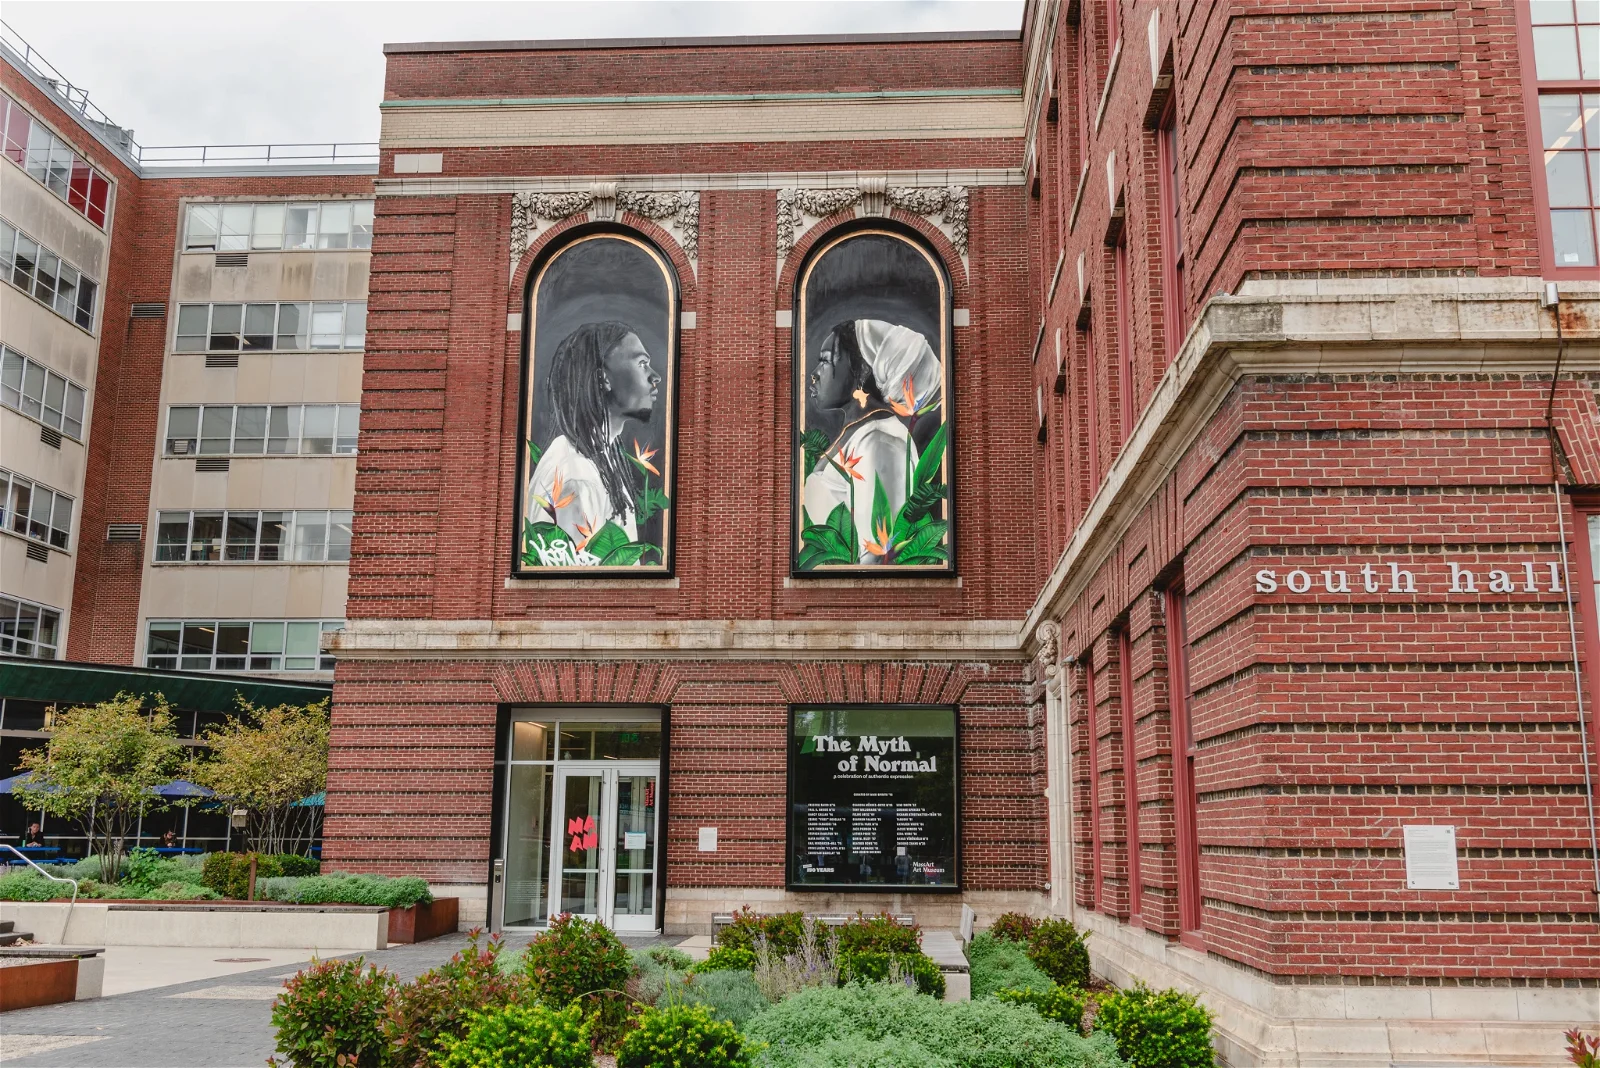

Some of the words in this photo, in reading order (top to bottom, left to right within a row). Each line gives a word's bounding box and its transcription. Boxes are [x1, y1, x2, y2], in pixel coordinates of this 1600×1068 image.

[1255, 562, 1418, 594] south
[1448, 561, 1564, 594] hall
[813, 735, 852, 752] The
[857, 735, 911, 756] Myth
[837, 755, 859, 772] of
[864, 756, 937, 772] Normal
